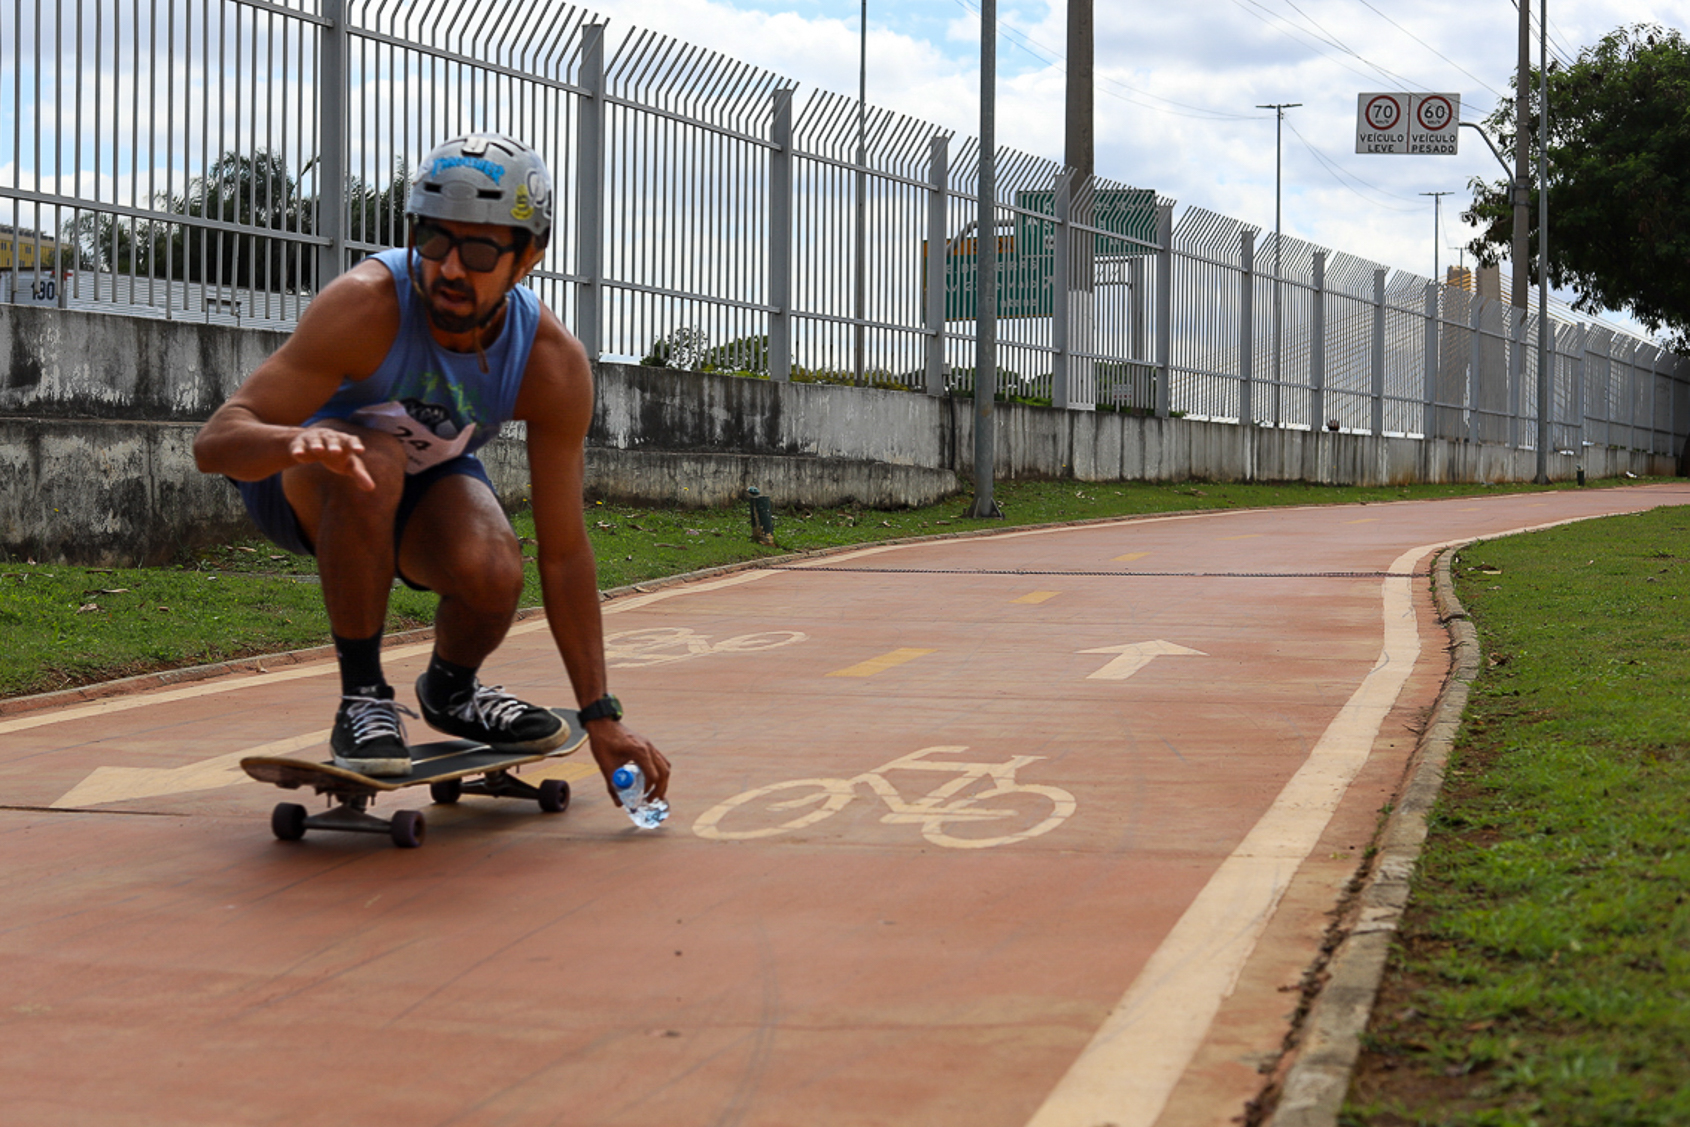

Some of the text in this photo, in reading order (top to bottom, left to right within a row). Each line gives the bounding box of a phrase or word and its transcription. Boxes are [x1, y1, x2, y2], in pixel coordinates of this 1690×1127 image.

[1373, 105, 1393, 119] 70
[1424, 105, 1445, 119] 60
[1368, 144, 1394, 153] LEVE
[1412, 144, 1455, 153] PESADO
